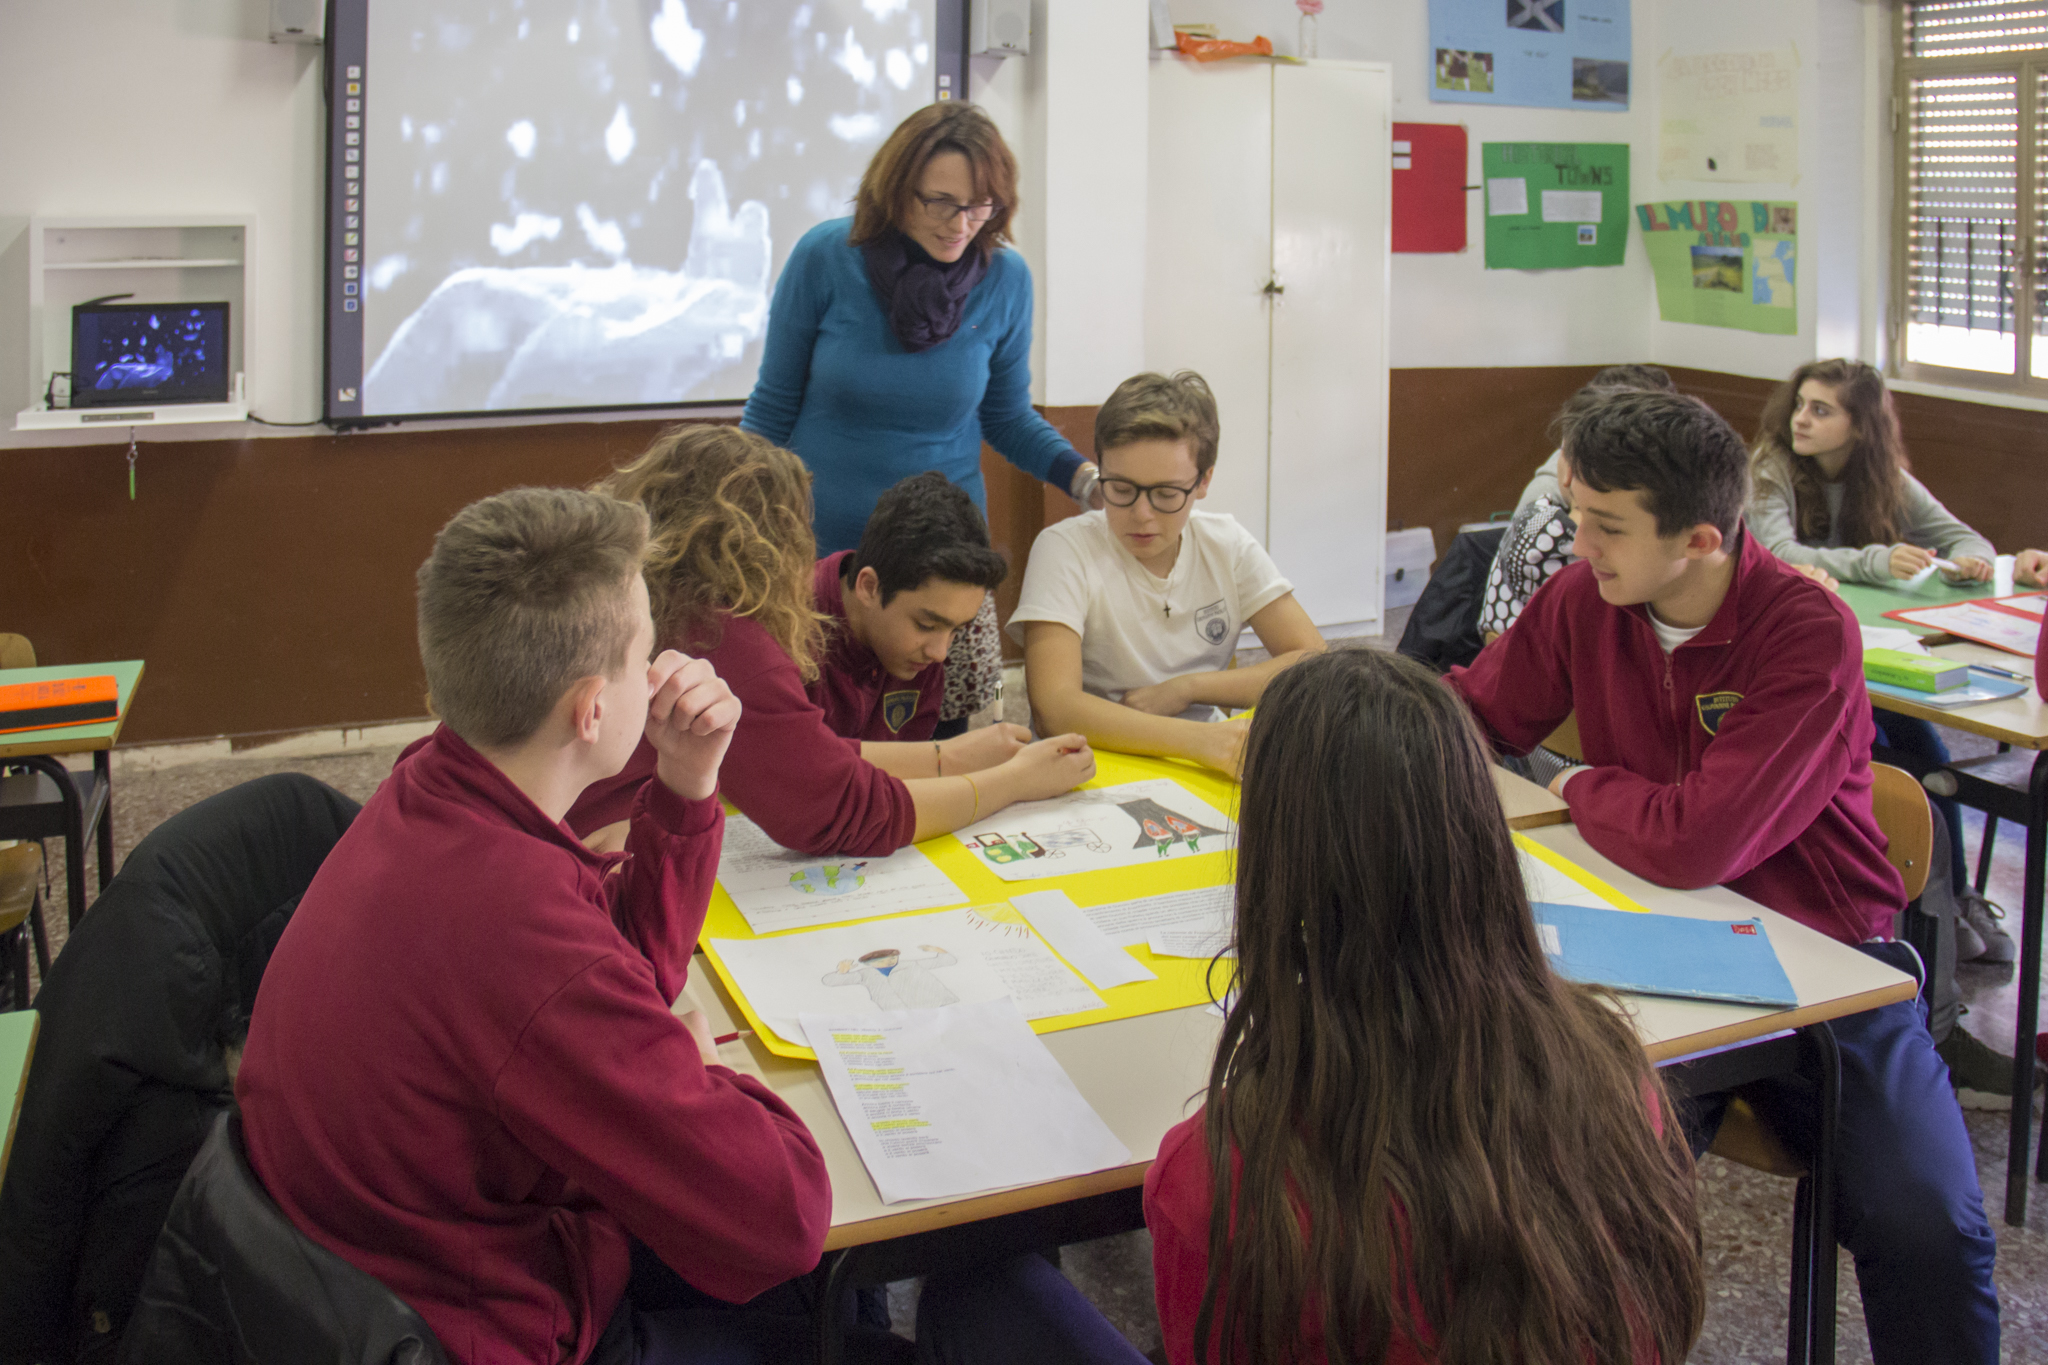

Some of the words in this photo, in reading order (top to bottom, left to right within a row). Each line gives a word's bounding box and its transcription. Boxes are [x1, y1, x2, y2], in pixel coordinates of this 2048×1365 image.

[1635, 203, 1670, 231] IL
[1664, 201, 1738, 232] MURO
[1751, 202, 1770, 233] DI
